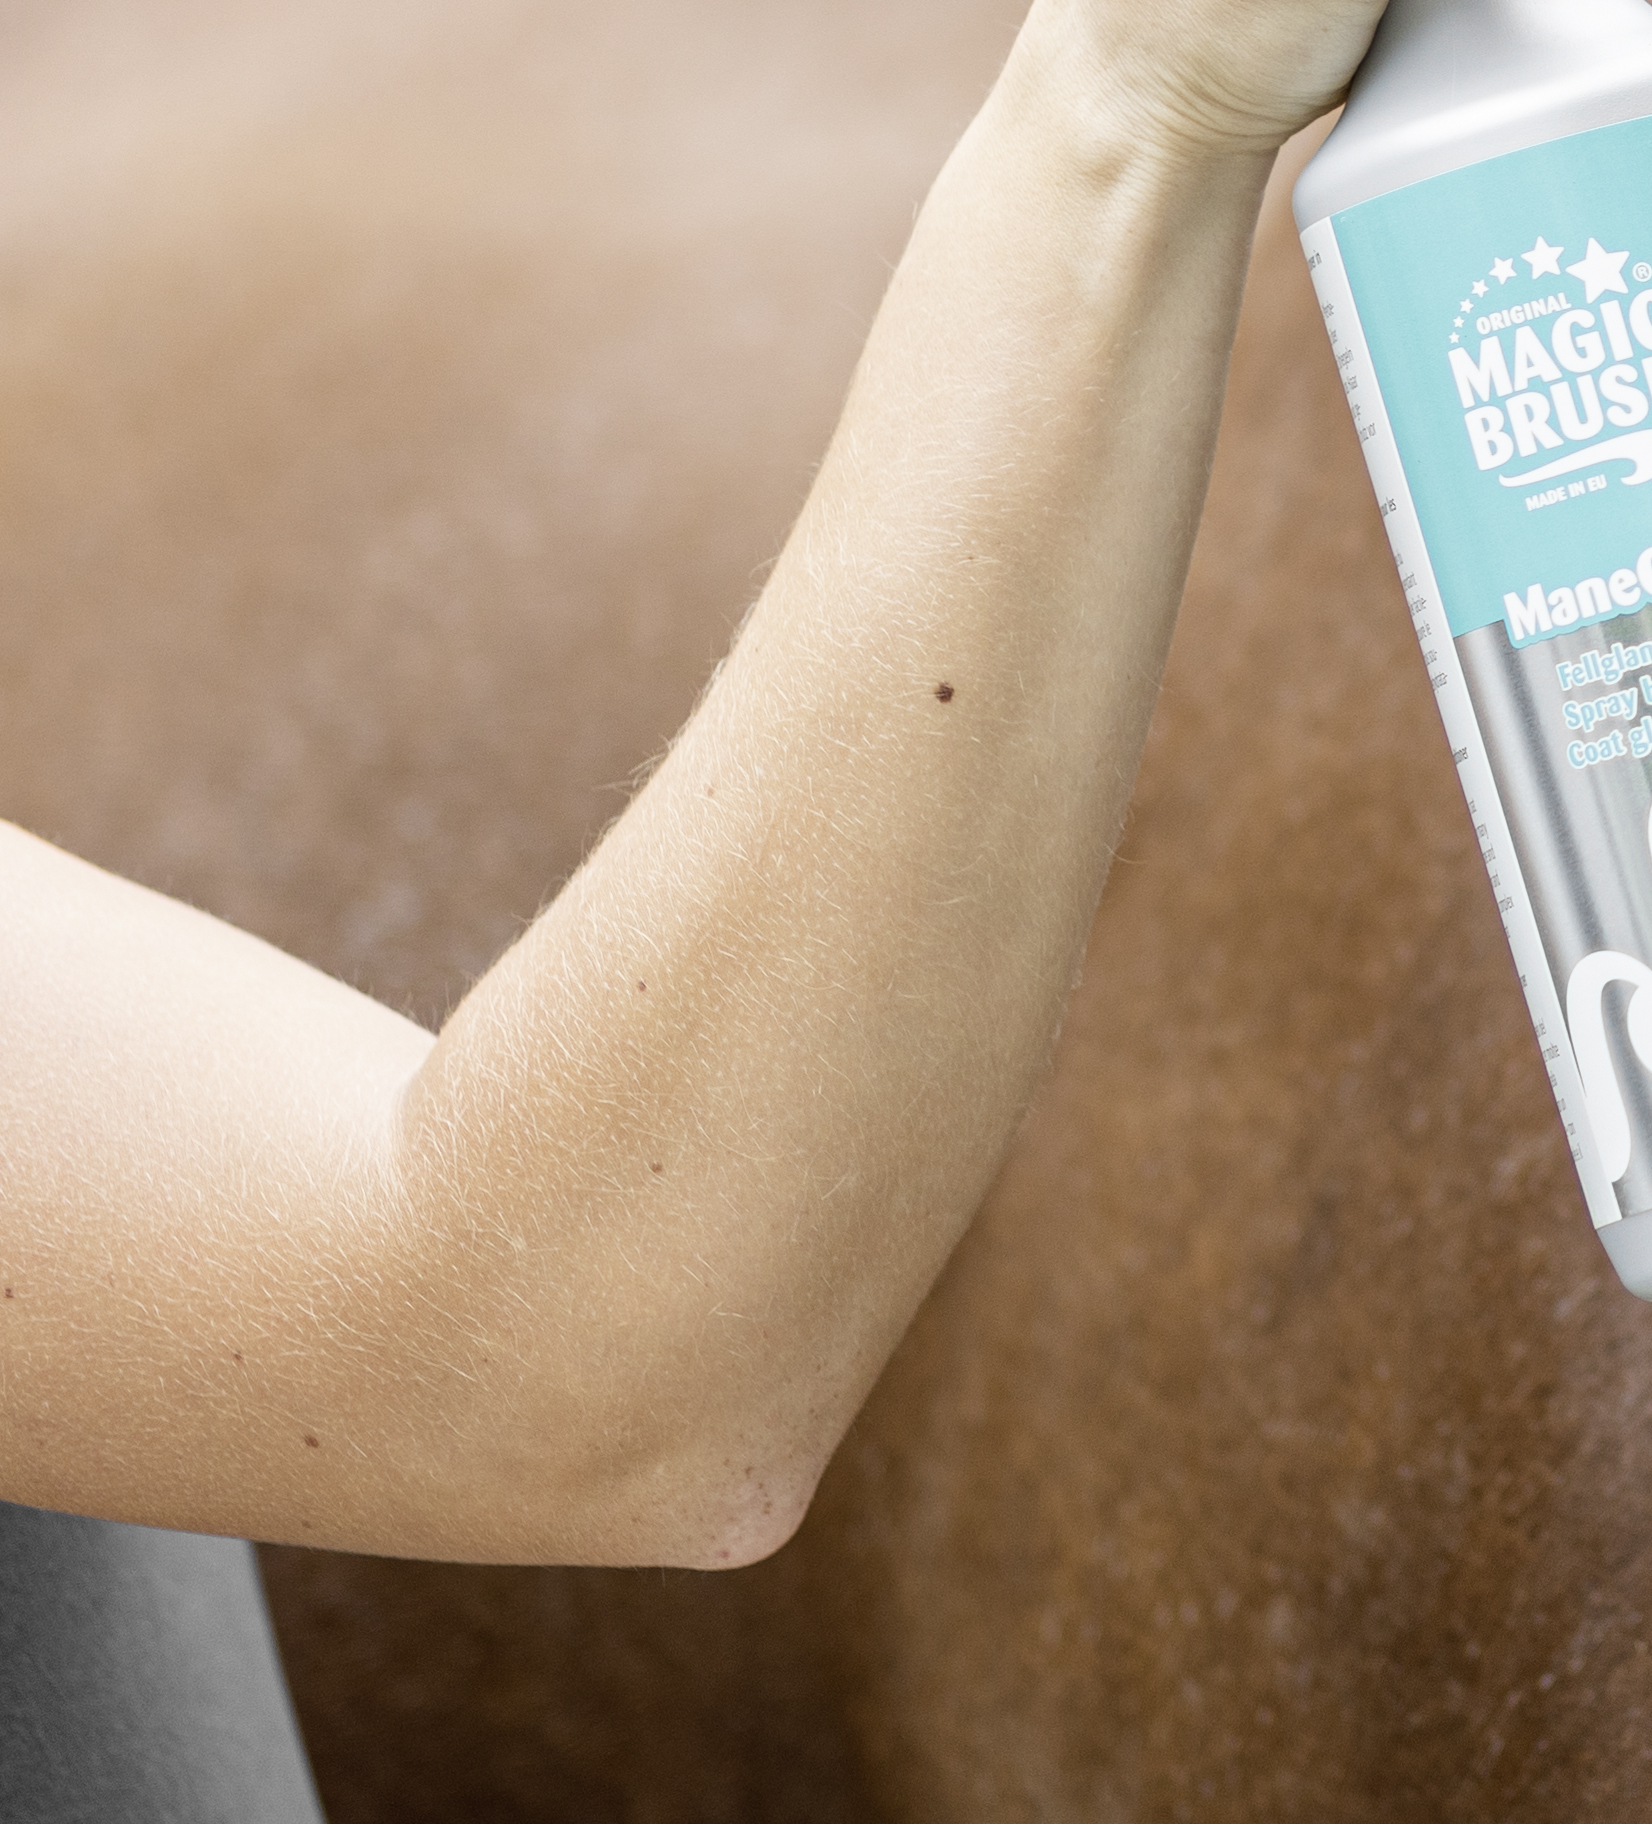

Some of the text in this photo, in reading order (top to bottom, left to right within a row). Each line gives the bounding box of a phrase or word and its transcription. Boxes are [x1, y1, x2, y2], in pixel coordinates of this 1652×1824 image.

[1475, 292, 1572, 335] ORIGINAL
[1525, 474, 1607, 512] MADE IN EU
[1563, 688, 1638, 731] Spray
[1568, 730, 1627, 768] Coat
